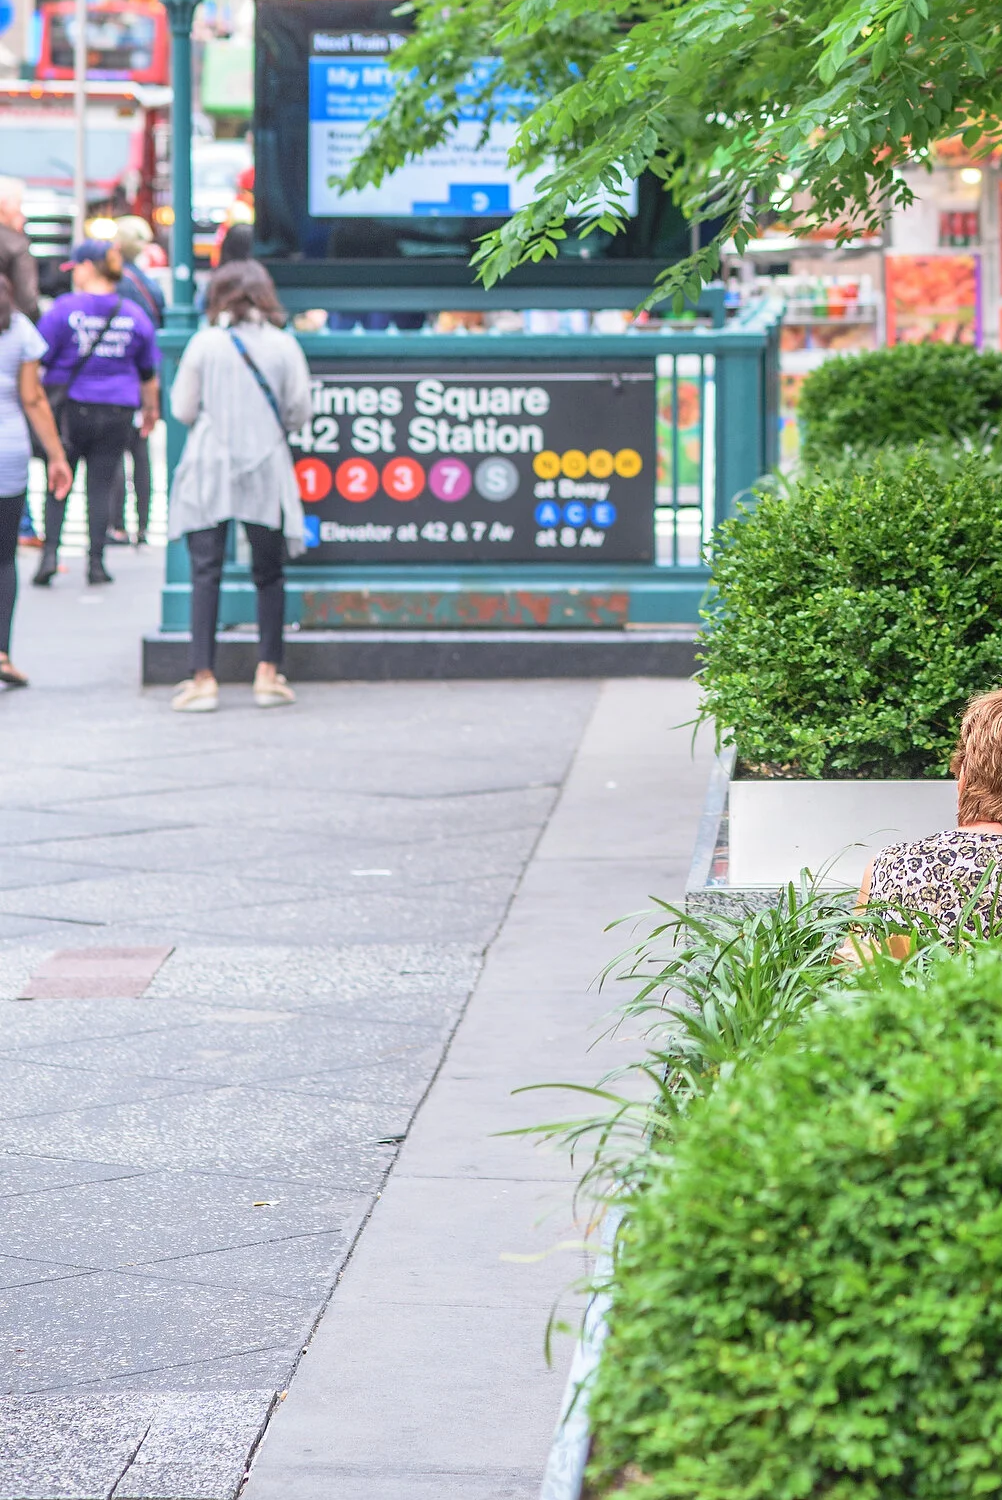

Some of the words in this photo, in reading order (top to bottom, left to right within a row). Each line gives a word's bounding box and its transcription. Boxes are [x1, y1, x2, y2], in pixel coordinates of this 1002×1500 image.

[313, 33, 350, 52] Next
[351, 33, 388, 52] Train
[327, 67, 358, 89] My
[415, 378, 551, 421] Square
[288, 417, 340, 453] 42
[350, 416, 397, 453] St
[408, 416, 544, 453] Station
[302, 467, 317, 494] 1
[347, 466, 368, 494] 2
[393, 466, 415, 494] 3
[439, 467, 462, 494] 7
[485, 465, 509, 494] S
[534, 480, 555, 499] at
[539, 504, 556, 524] A
[566, 504, 582, 524] C
[594, 504, 609, 524] E
[319, 521, 394, 543] Elevator
[396, 522, 418, 542] at
[421, 521, 449, 542] 42
[451, 522, 468, 542] &
[471, 522, 487, 542] 7
[489, 522, 515, 543] Av
[535, 527, 557, 548] at
[579, 526, 606, 548] Av
